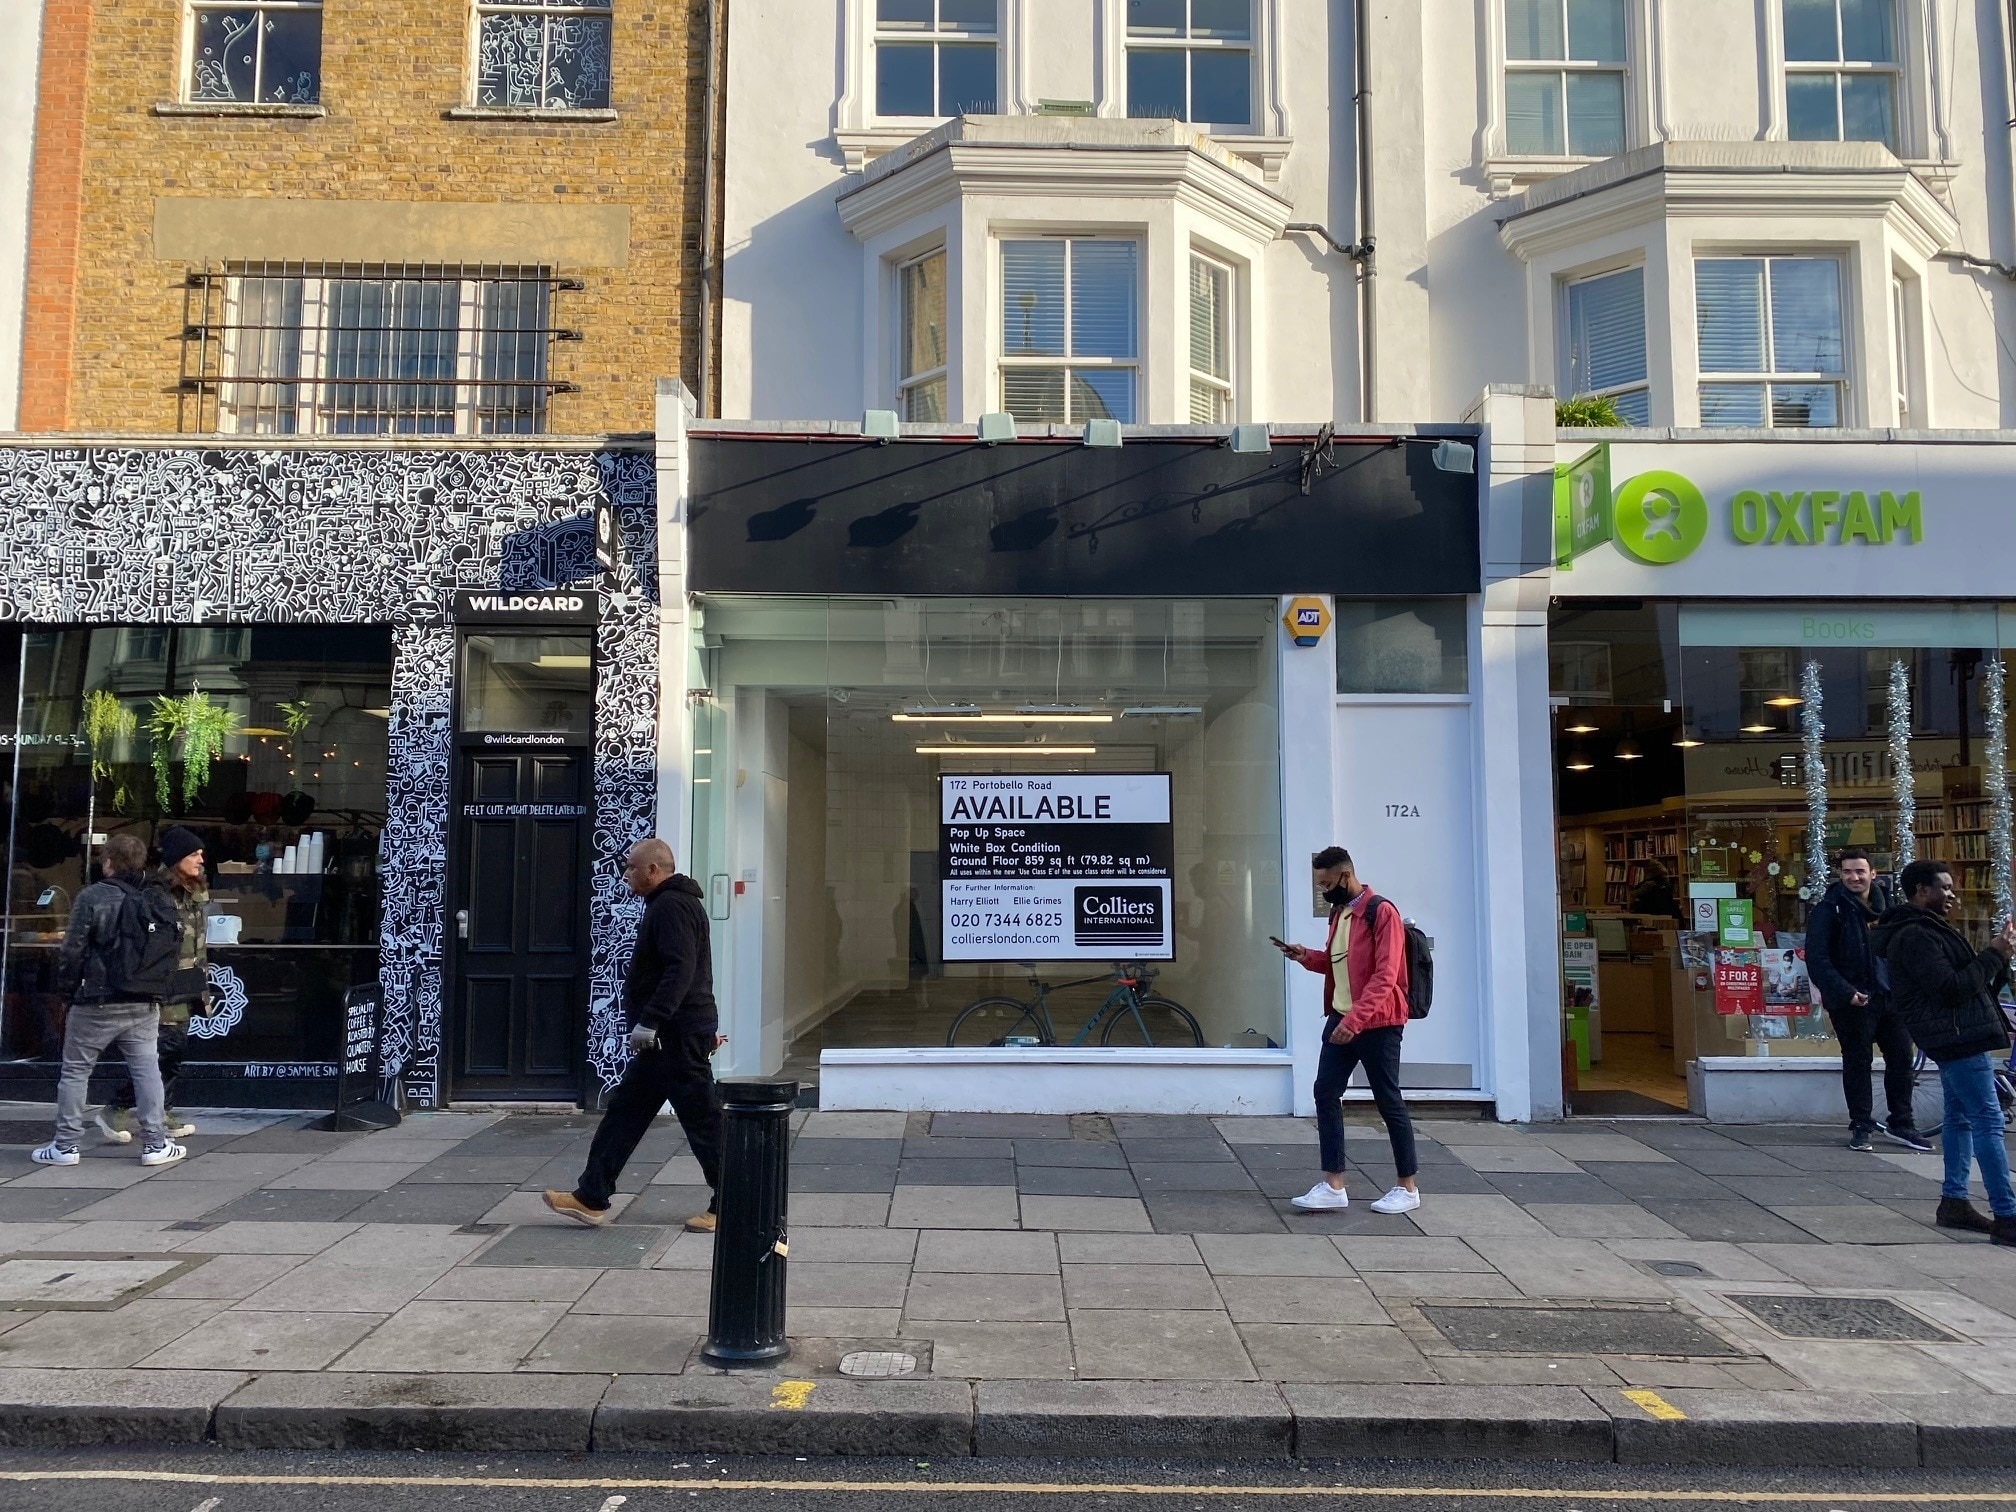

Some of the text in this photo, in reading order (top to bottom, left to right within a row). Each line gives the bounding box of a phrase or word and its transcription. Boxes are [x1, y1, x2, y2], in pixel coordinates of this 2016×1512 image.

[54, 449, 79, 461] HEY
[174, 518, 199, 527] HELLO
[1732, 489, 1923, 544] OXFAM
[1576, 512, 1600, 539] OXFAM
[468, 596, 583, 611] WILDCARD
[1298, 611, 1320, 623] ADT
[1803, 617, 1875, 639] Books
[484, 734, 565, 744] @wildcardlondon
[950, 781, 1052, 790] 172 Portobello Road
[463, 805, 485, 815] FELT
[486, 805, 504, 815] CUTE
[505, 805, 529, 815] MIGHT
[529, 805, 554, 815] DELETE
[554, 805, 576, 815] LATER
[950, 795, 1111, 819] AVAILABLE
[1385, 805, 1420, 817] 172A
[950, 828, 1026, 840] Pop Up Space
[950, 843, 1061, 853] White Box Condition
[950, 855, 1151, 868] Ground Floor 859 sq ft (79.82 sq m)
[950, 868, 958, 876] All
[974, 868, 991, 876] within
[993, 868, 1002, 876] the
[950, 897, 1062, 907] Harry Elliott Ellie Grimes
[1083, 896, 1155, 915] Colliers
[951, 913, 1063, 927] 020 7344 6825
[951, 933, 1060, 944] collierslondon.com
[1574, 942, 1594, 950] OPEN
[1564, 950, 1582, 958] GAIN
[1720, 971, 1758, 981] 3 FOR 2
[347, 1014, 366, 1030] COFFEE
[244, 1065, 261, 1077] ART
[261, 1066, 275, 1077] BY
[345, 1058, 367, 1074] HORSE
